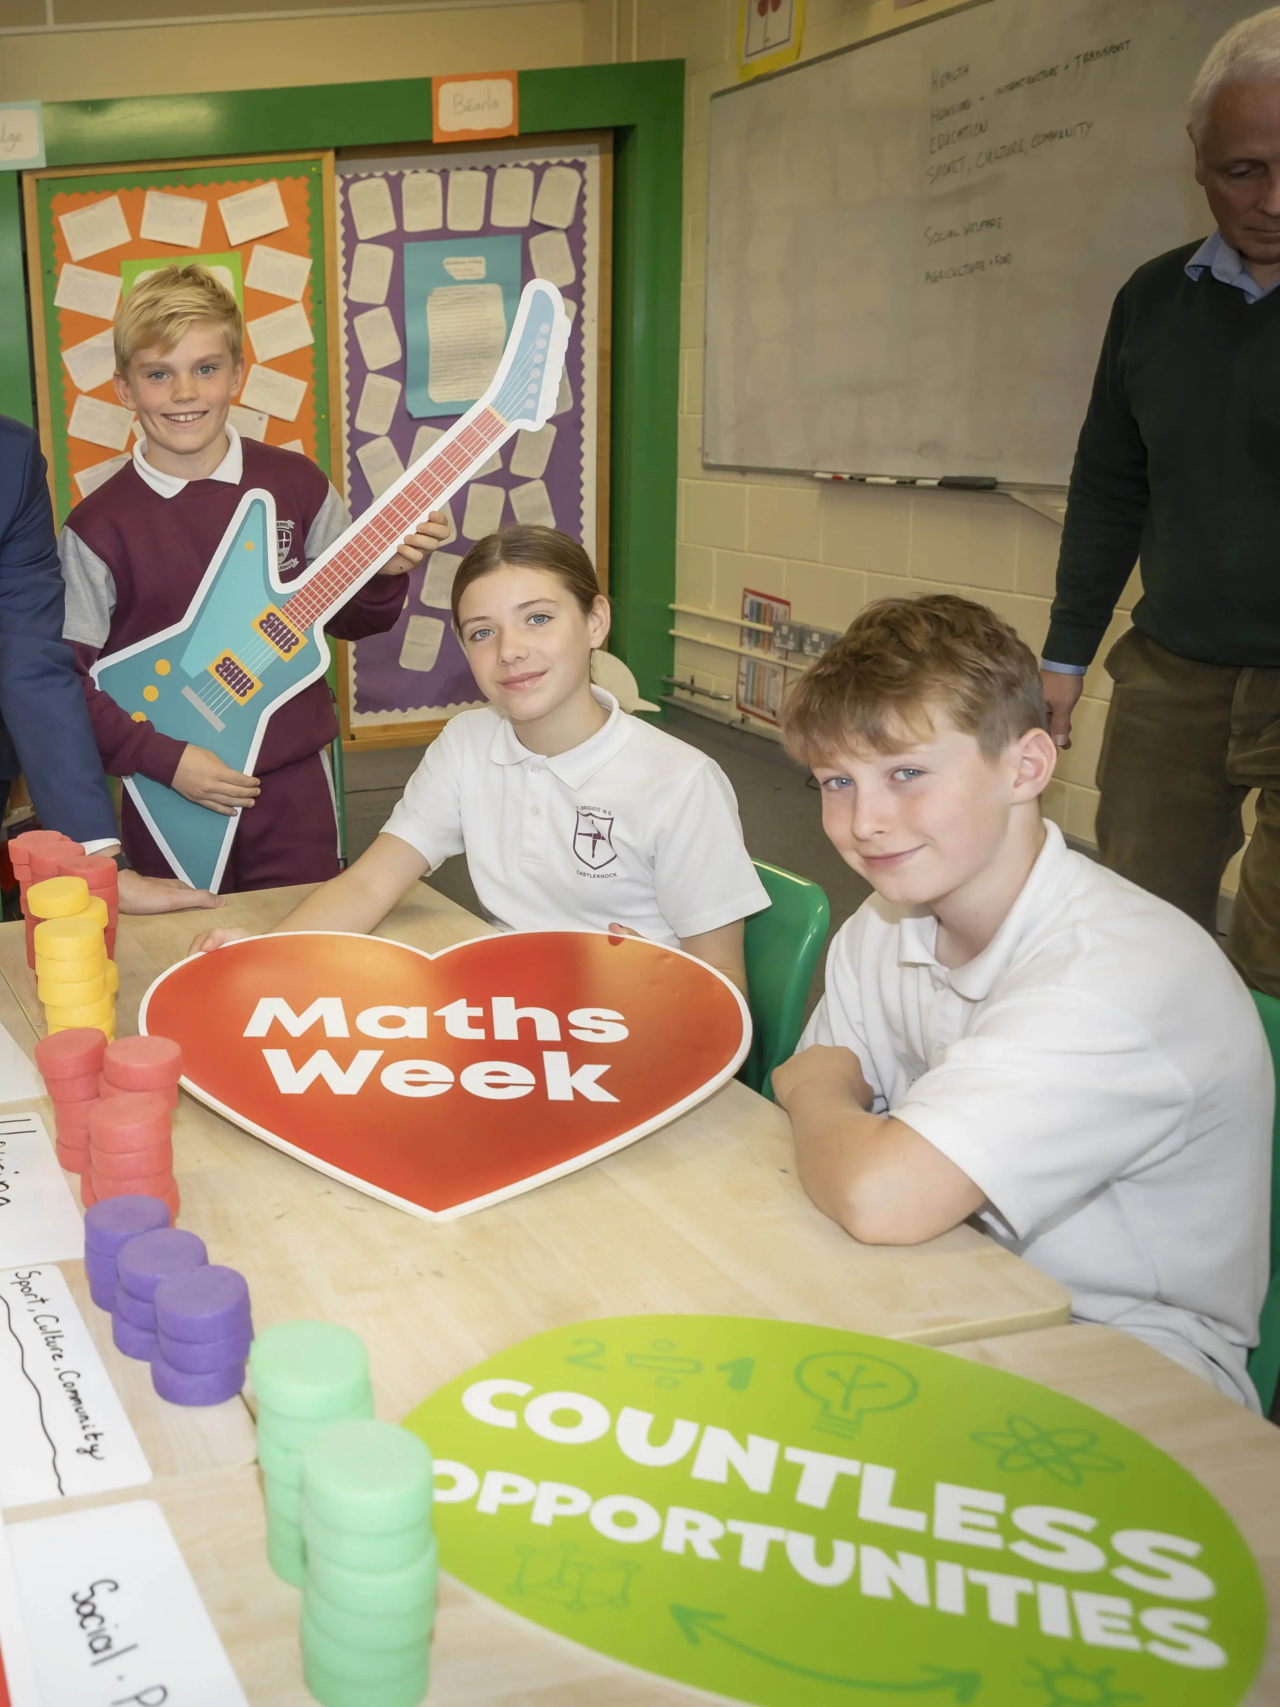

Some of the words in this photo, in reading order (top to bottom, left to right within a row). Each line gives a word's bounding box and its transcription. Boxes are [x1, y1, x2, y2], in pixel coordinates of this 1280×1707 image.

[929, 119, 988, 155] EDUCATION
[576, 869, 618, 879] CASTLEKNOCK
[243, 997, 630, 1043] Maths
[262, 1049, 620, 1103] Week
[58, 1370, 104, 1461] Community
[462, 1378, 1217, 1600] COUNTLESS
[432, 1460, 1228, 1669] OPPORTUNITIES
